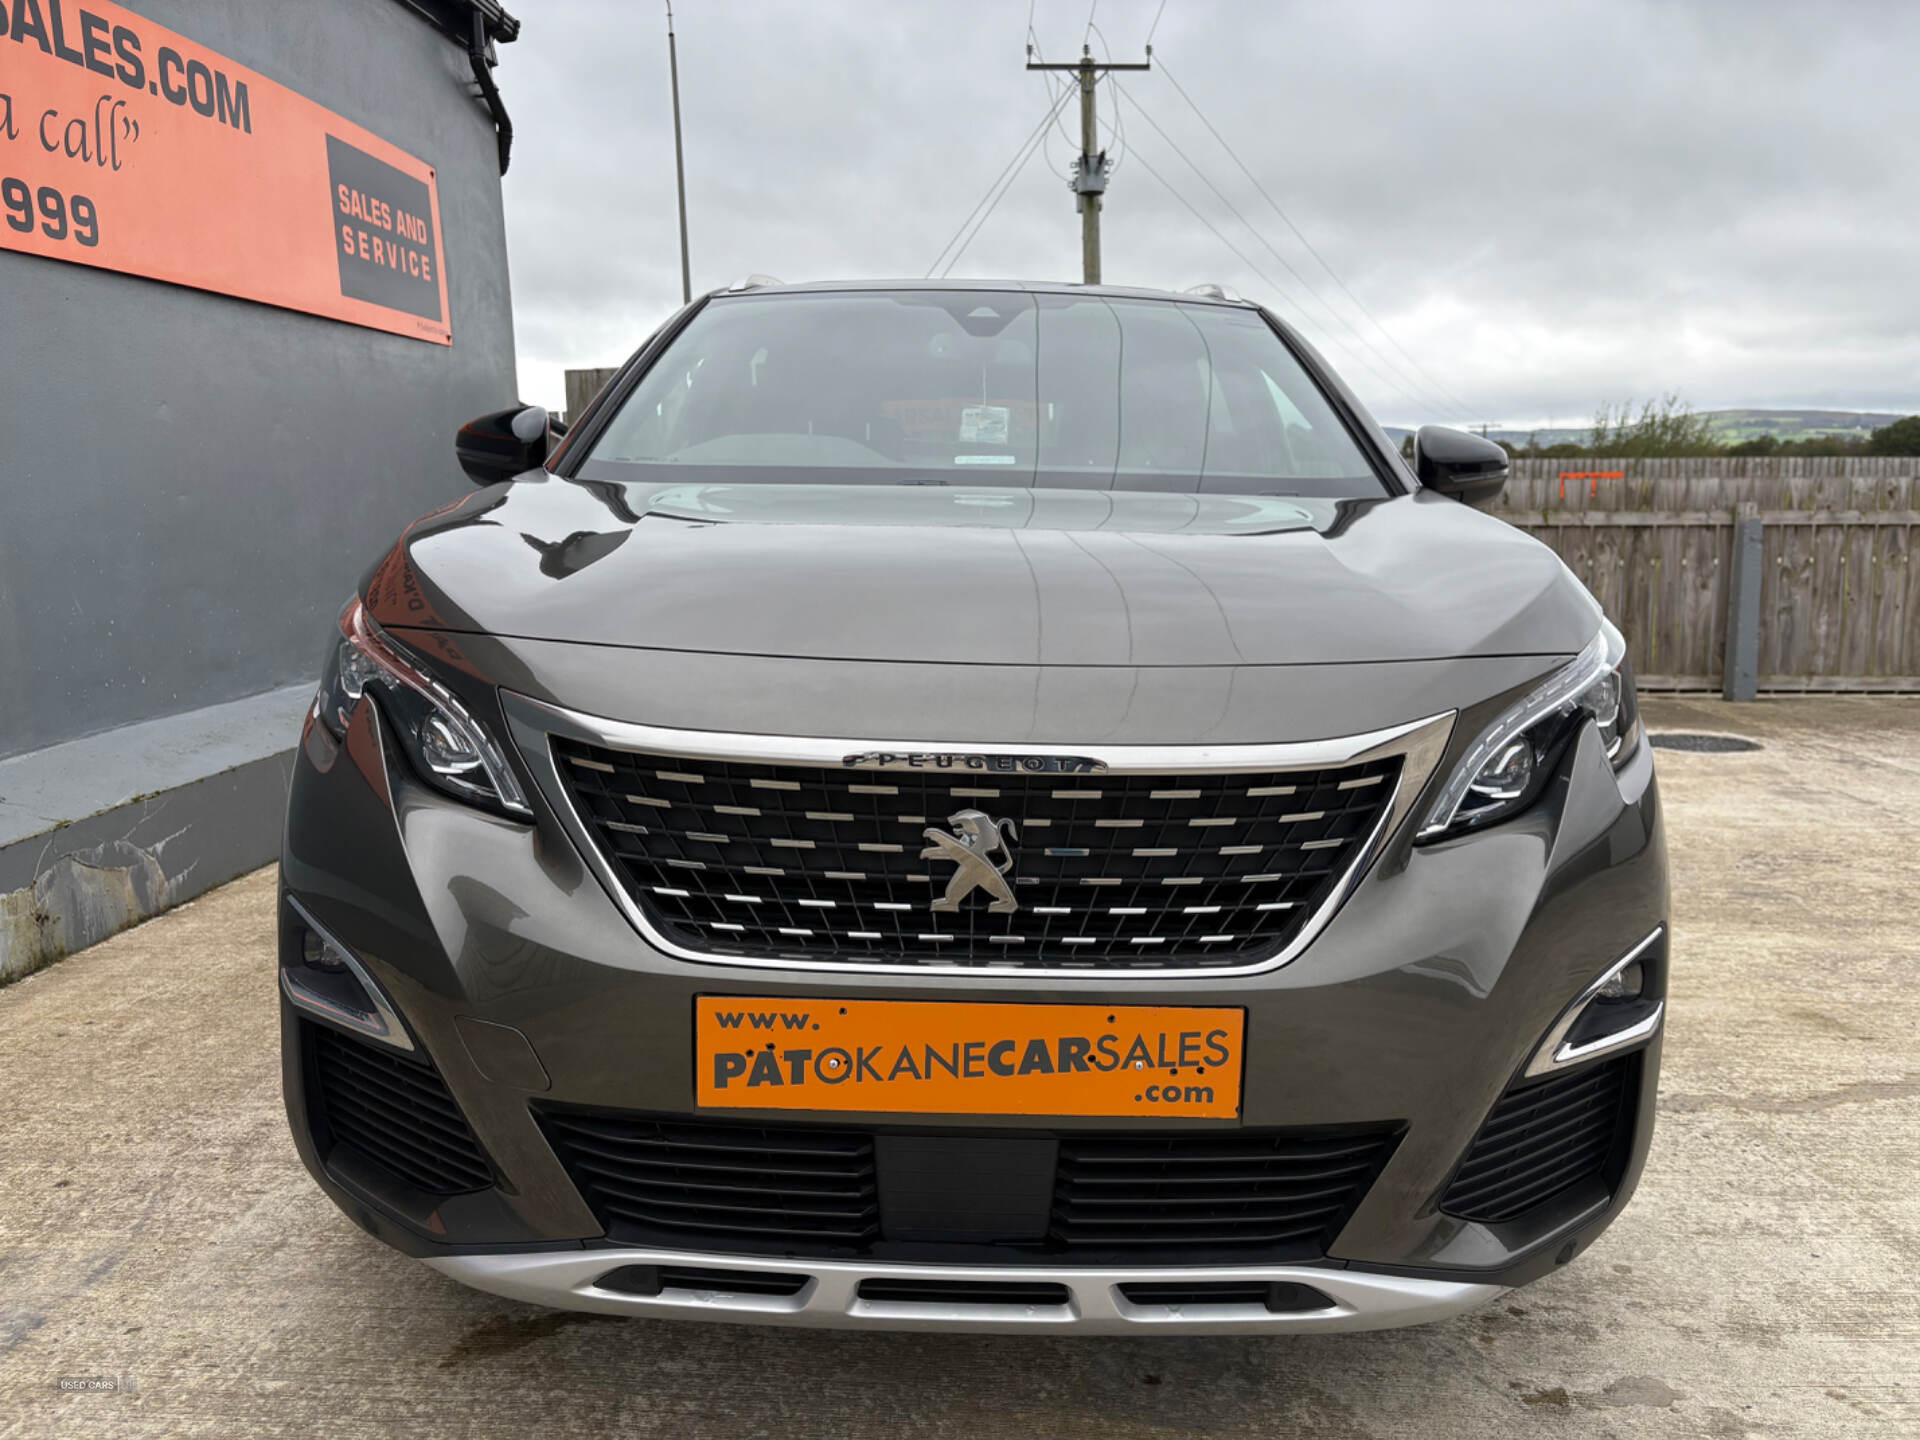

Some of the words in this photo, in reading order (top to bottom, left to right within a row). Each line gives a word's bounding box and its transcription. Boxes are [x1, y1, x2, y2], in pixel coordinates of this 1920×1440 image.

[0, 0, 252, 135] ALES.COM
[1, 176, 99, 247] 999
[338, 183, 392, 231] SALES
[396, 209, 428, 245] AND
[342, 224, 432, 282] SERVICE
[878, 752, 1071, 773] PEUGEOT
[714, 1011, 820, 1031] www.
[1134, 1085, 1214, 1103] .com
